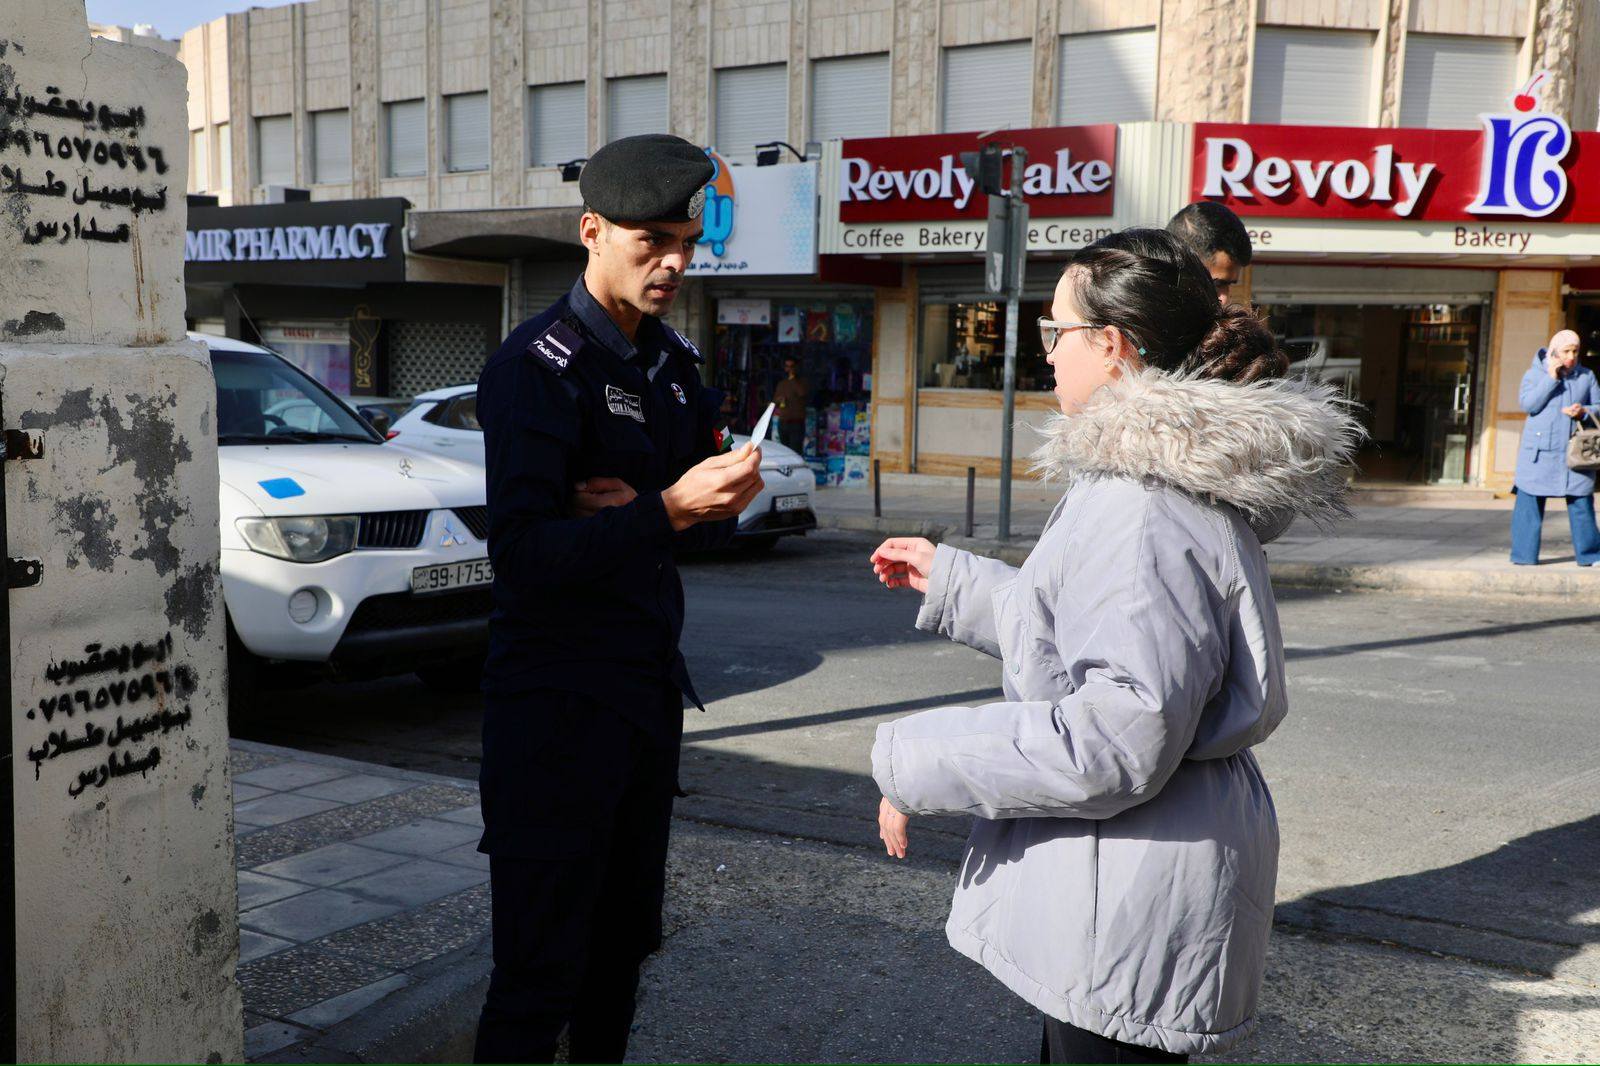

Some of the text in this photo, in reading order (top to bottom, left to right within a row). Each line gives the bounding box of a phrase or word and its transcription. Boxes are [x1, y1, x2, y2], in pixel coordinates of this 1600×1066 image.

[840, 154, 975, 210] Revoly
[1202, 137, 1437, 217] Revoly
[233, 222, 390, 260] PHARMACY
[843, 225, 985, 250] Coffee Bakery
[1455, 225, 1532, 252] Bakery
